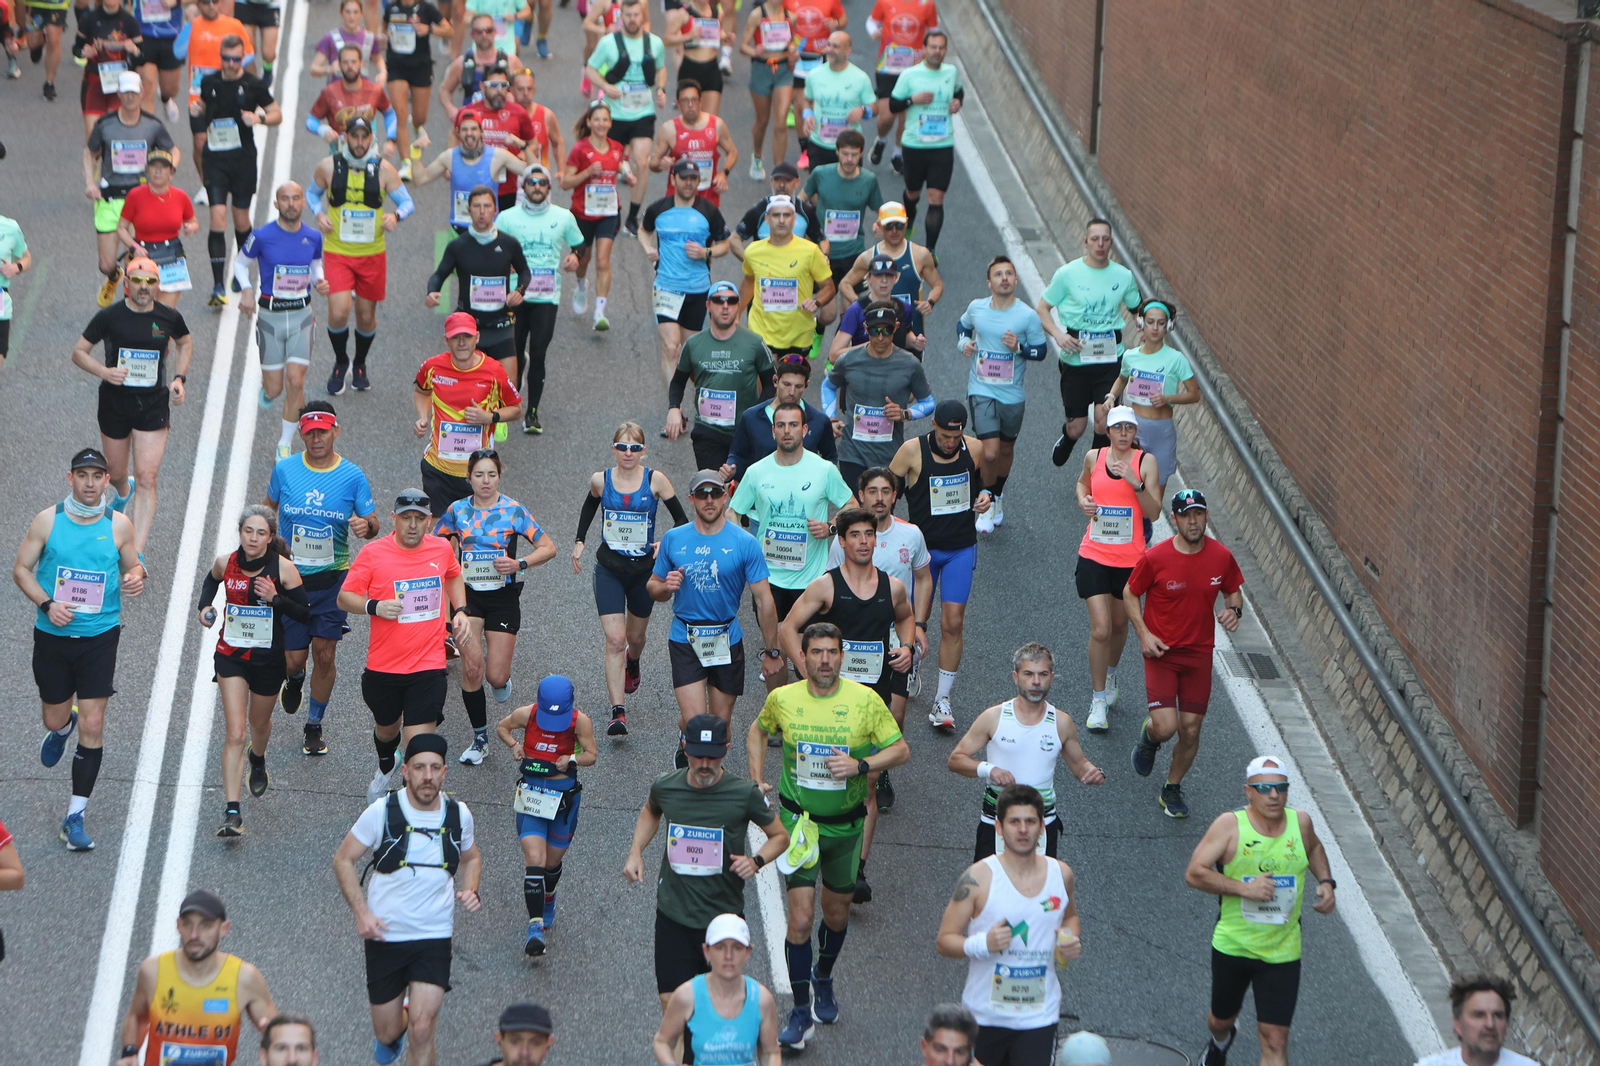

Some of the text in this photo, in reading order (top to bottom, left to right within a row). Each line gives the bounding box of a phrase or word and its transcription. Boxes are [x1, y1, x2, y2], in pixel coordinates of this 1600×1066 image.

[484, 277, 503, 285] ZURICH
[273, 300, 303, 308] WONG
[133, 352, 155, 360] ZURICH
[989, 352, 1010, 361] ZURICH
[1140, 372, 1161, 381] ZURICH
[710, 392, 731, 400] ZURICH
[945, 476, 966, 485] ZURICH
[284, 503, 345, 520] GranCanaria
[619, 514, 643, 522] ZURICH
[768, 521, 805, 530] SEVILLA'24
[307, 530, 328, 538] ZURICH
[618, 526, 632, 534] 9273
[778, 533, 802, 541] ZURICH
[695, 545, 711, 555] edp
[776, 545, 793, 553] 10004
[475, 566, 490, 574] 9125
[74, 572, 101, 582] ZURICH
[411, 579, 436, 588] ZURICH
[72, 586, 88, 594] 8186
[72, 595, 87, 603] BEAN
[413, 595, 428, 603] 7475
[241, 608, 267, 616] ZURICH
[241, 622, 256, 630] 9532
[242, 631, 254, 639] TERE
[851, 657, 867, 665] 9985
[847, 665, 869, 673] IGNACIO
[526, 797, 542, 806] 9302
[687, 830, 715, 839] ZURICH
[686, 845, 703, 854] 8020
[155, 1020, 233, 1039] ATHLE 91
[184, 1049, 219, 1060] ZURICH
